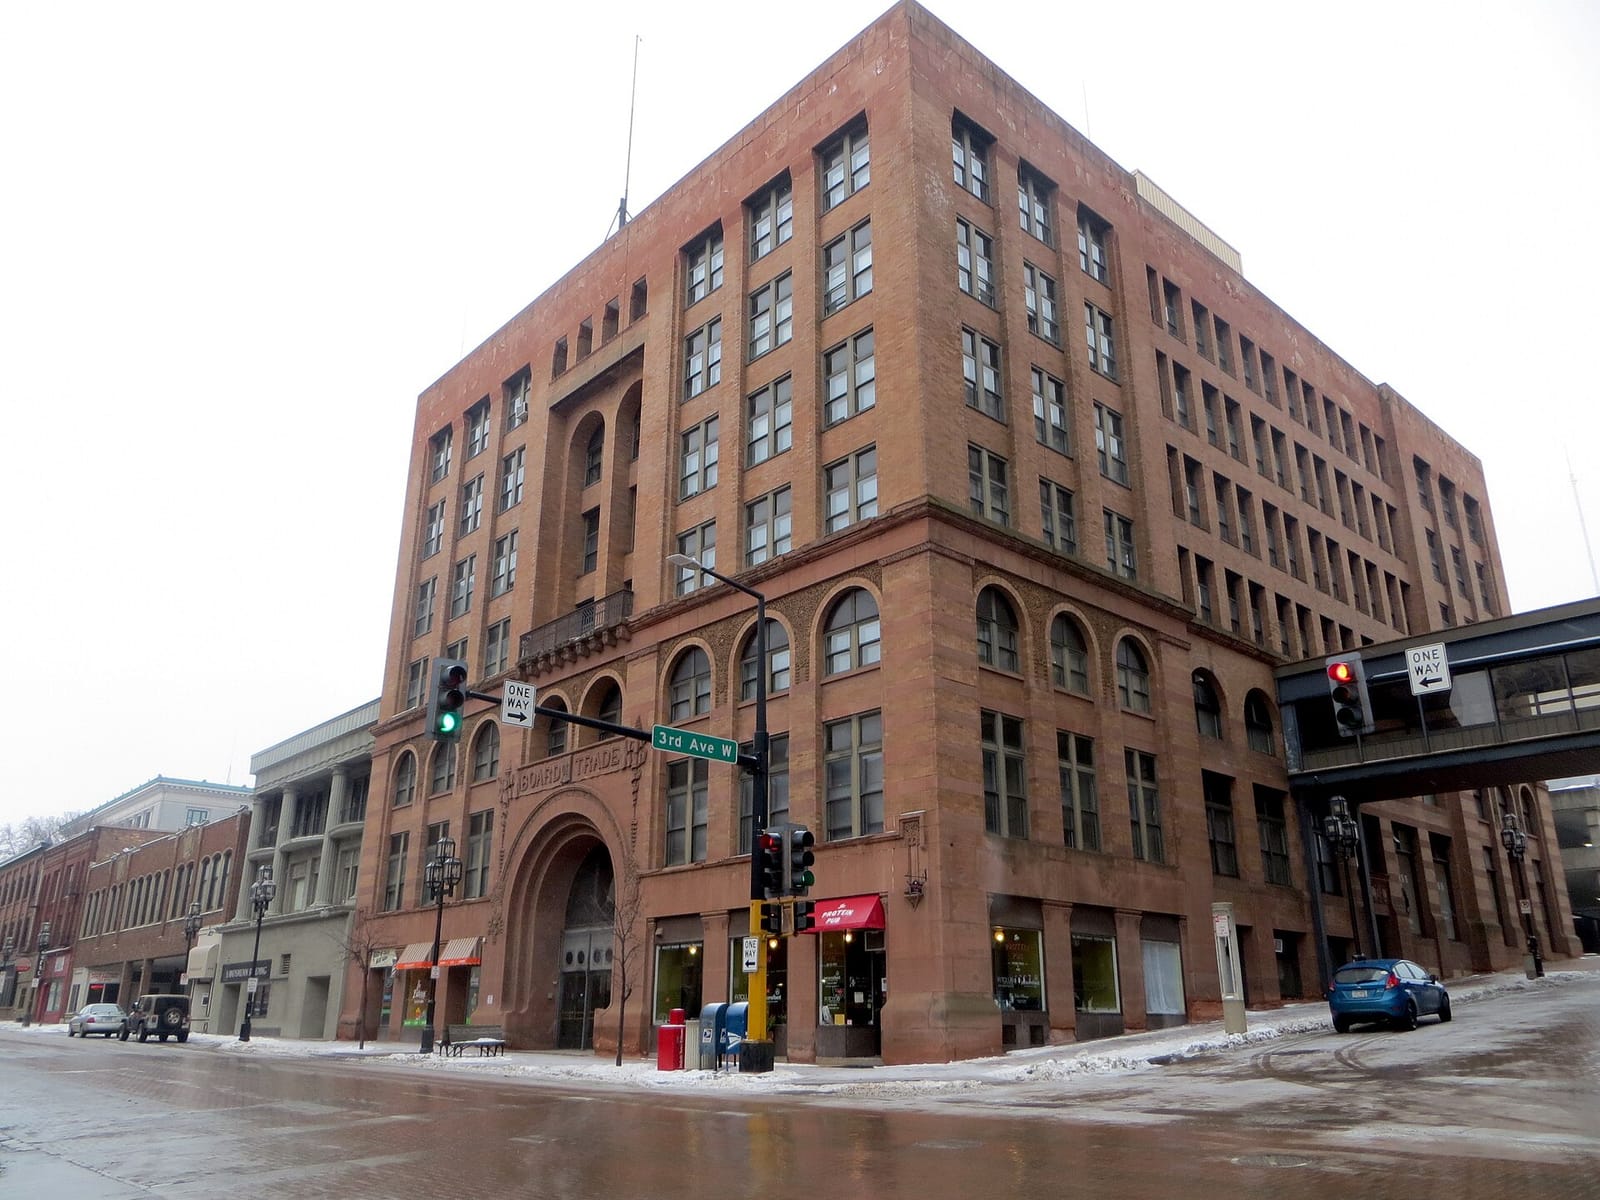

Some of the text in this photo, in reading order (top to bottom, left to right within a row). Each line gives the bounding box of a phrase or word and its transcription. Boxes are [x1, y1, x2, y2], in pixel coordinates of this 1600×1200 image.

[1412, 649, 1440, 663] ONE
[1414, 662, 1440, 676] WAY
[508, 685, 531, 698] ONE
[507, 697, 530, 711] WAY
[659, 731, 732, 758] 3rd Ave W
[518, 765, 561, 792] BOARD
[575, 747, 620, 777] TRADE
[821, 909, 854, 919] PROTEIN
[744, 940, 757, 949] ONE
[744, 949, 756, 958] WAY
